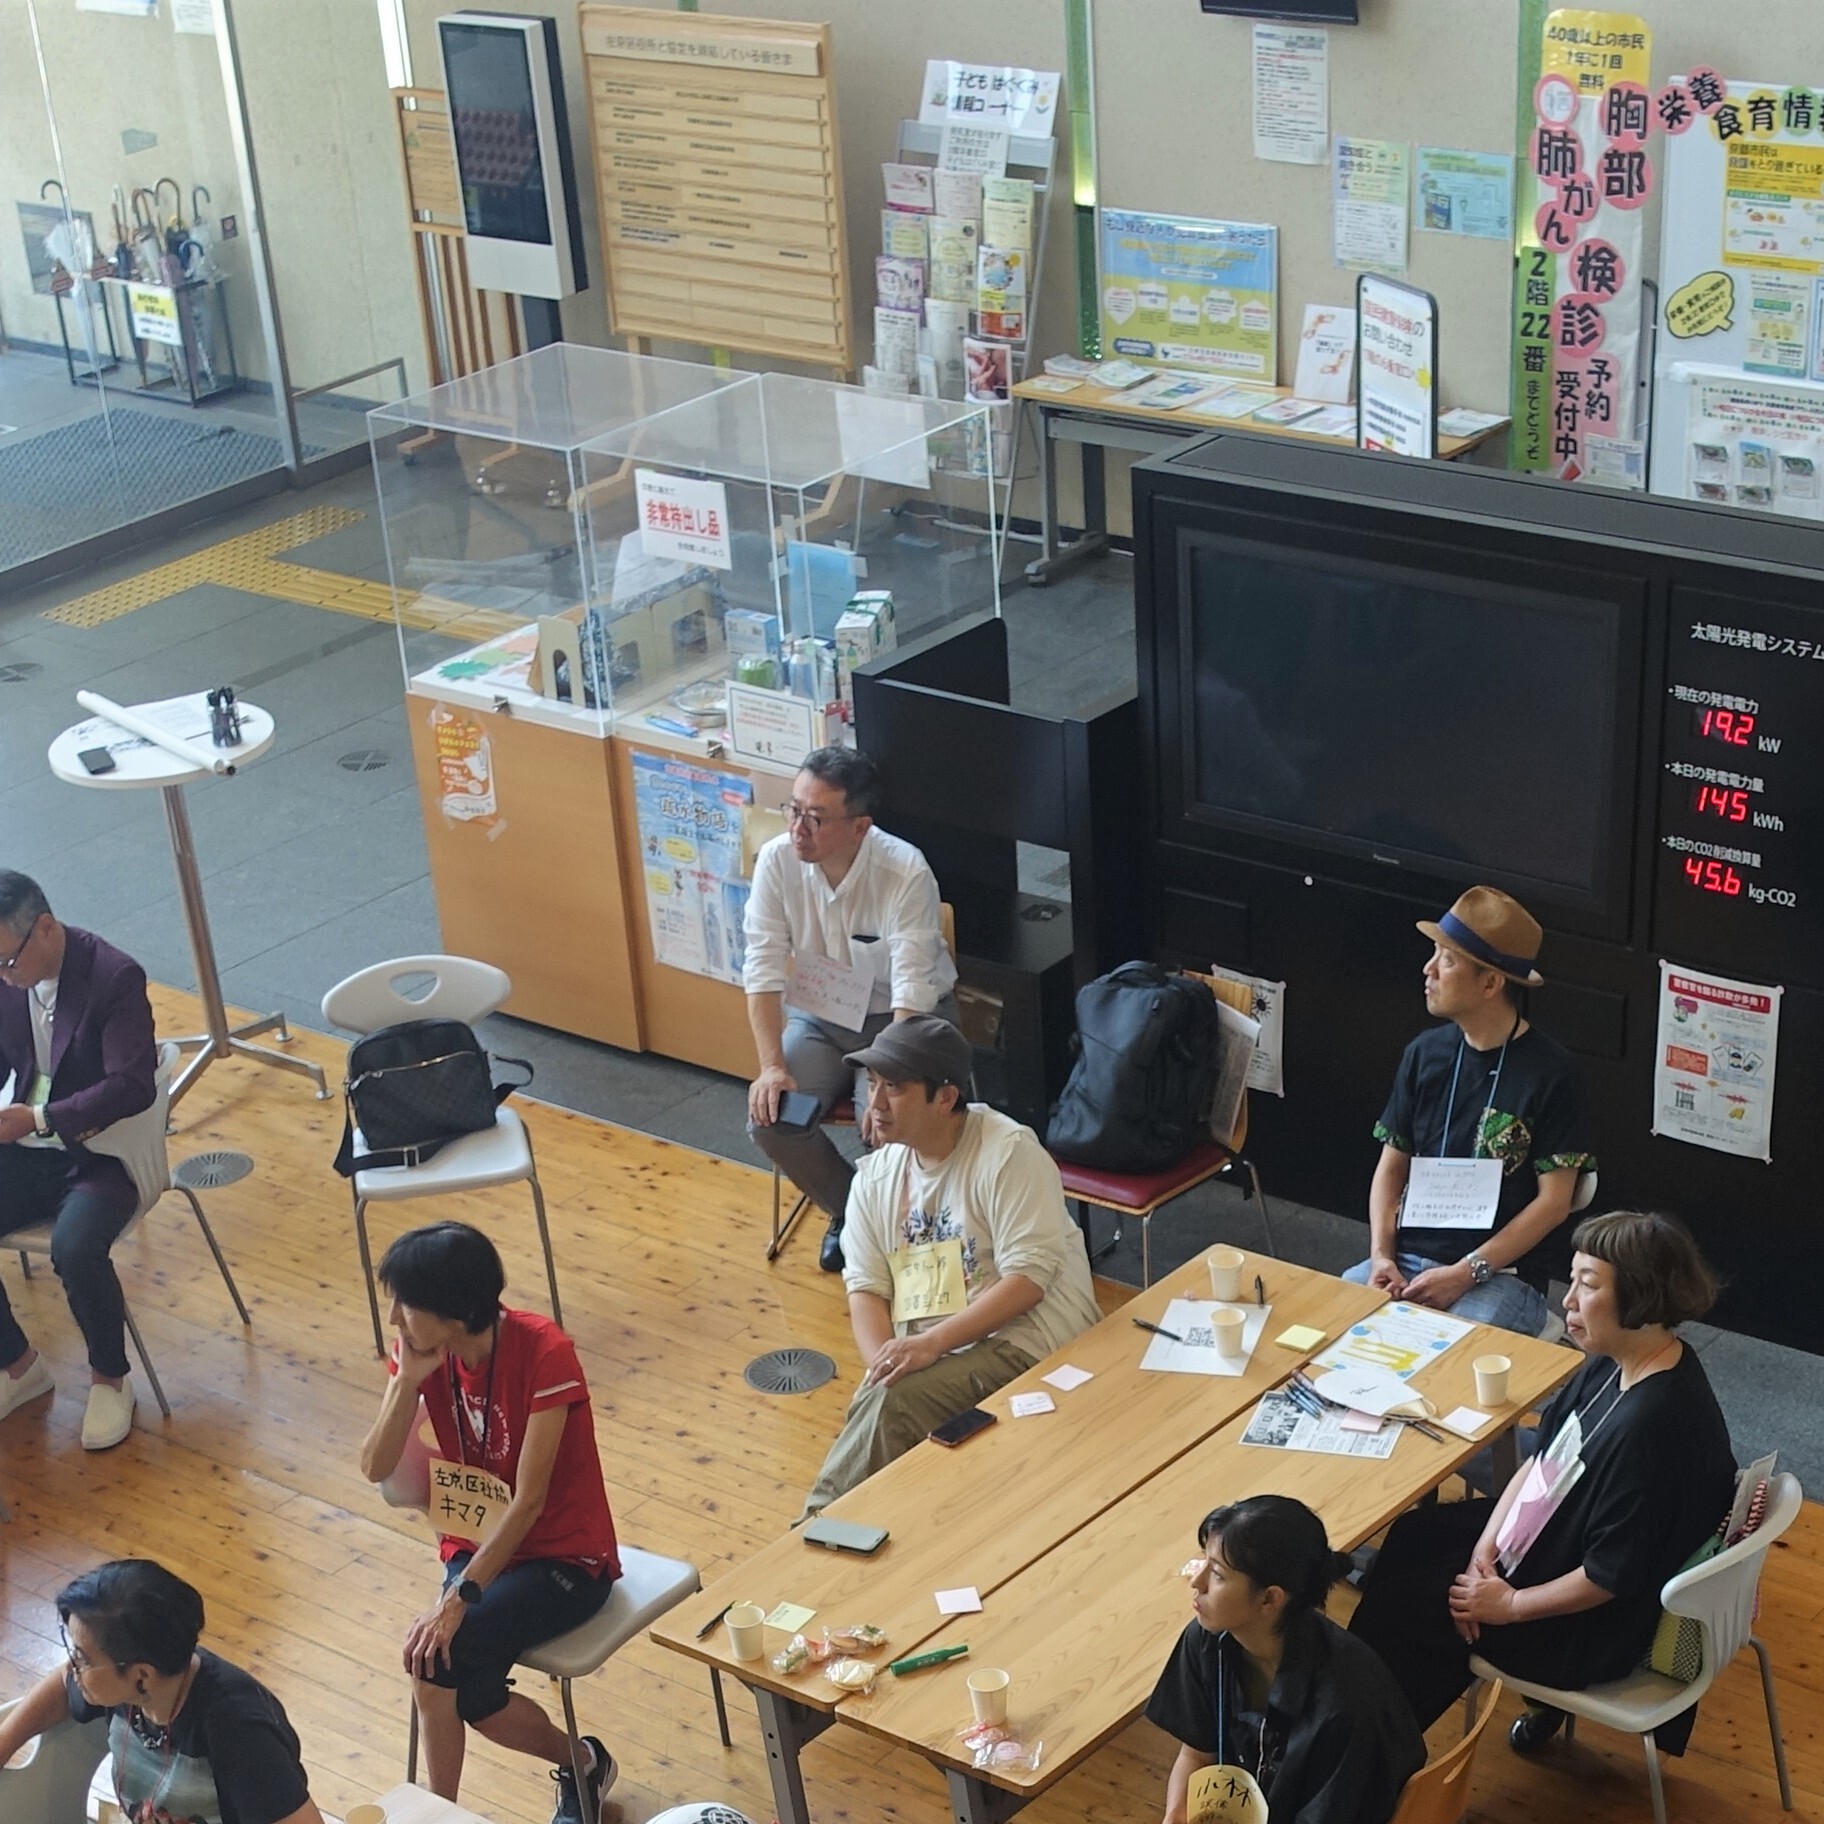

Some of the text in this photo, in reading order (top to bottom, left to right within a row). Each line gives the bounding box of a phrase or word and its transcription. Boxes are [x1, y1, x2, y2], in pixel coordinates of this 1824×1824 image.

[1604, 88, 1648, 199] 胸部
[1537, 128, 1593, 245] 肺がん
[1560, 244, 1618, 348] 検診
[1586, 358, 1613, 422] 予約
[1555, 371, 1581, 461] 受付中
[646, 499, 720, 536] 非常持出し品
[1703, 710, 1782, 753] 19.2 kW
[1698, 787, 1784, 832] 145 kWh
[1686, 858, 1796, 908] 45.6 kg-CO2
[440, 1494, 487, 1528] キマタ
[1197, 1777, 1252, 1806] 小林
